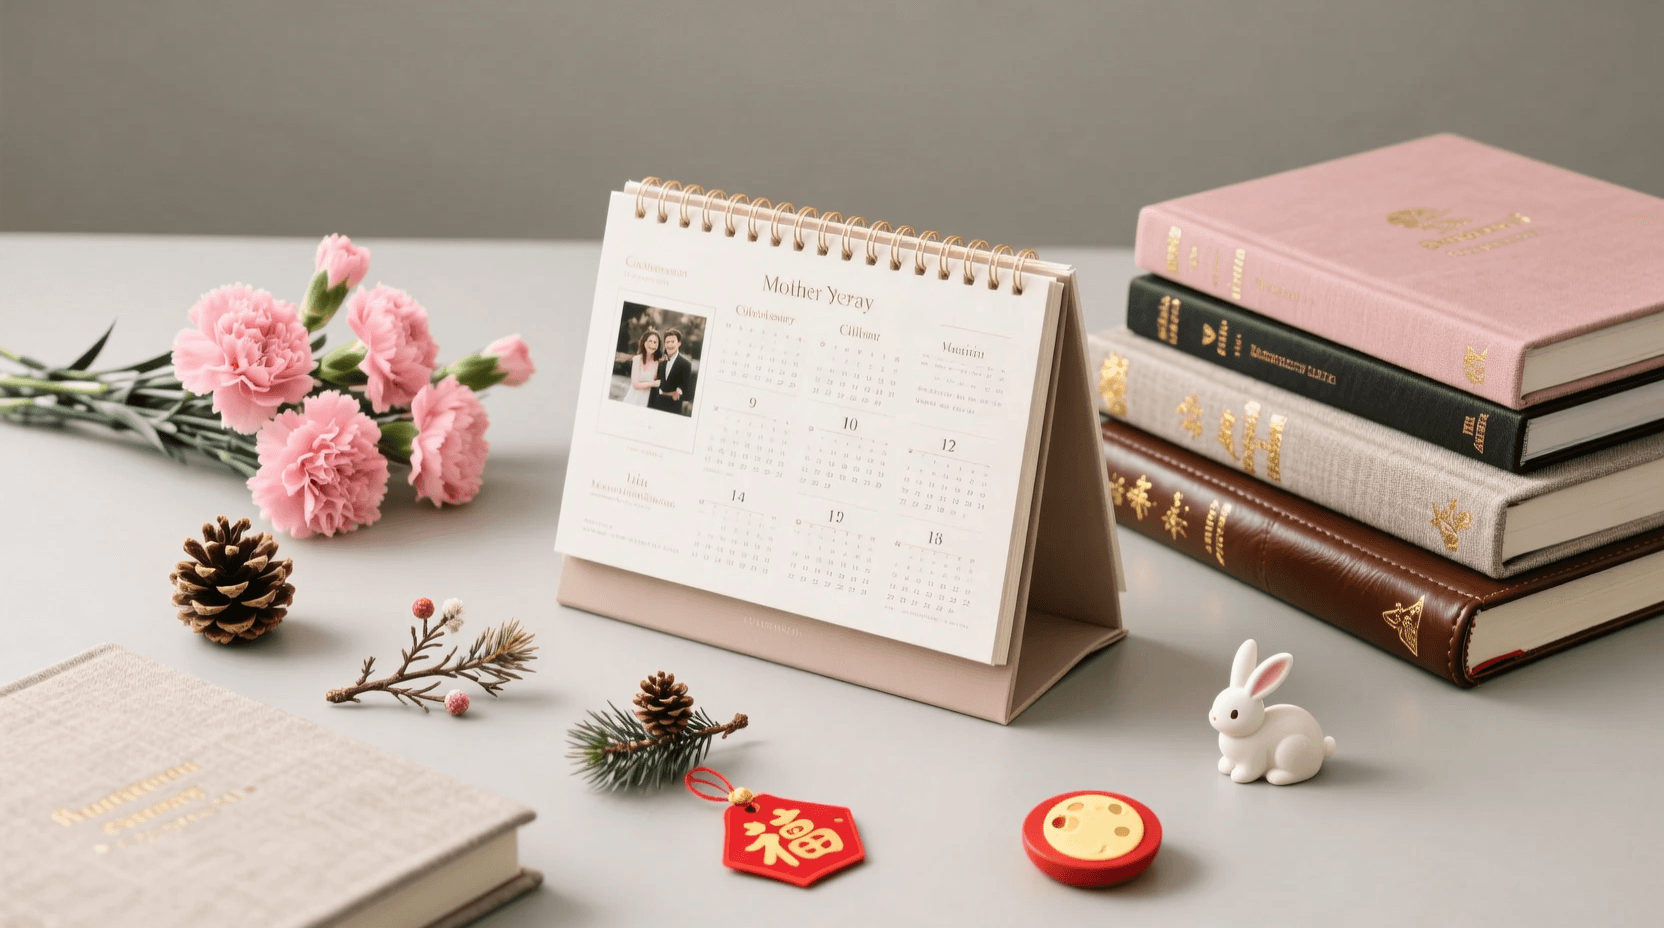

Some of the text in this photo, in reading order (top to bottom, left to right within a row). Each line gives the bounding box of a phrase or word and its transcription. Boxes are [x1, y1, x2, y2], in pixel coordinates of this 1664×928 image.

[763, 274, 874, 314] Mother Yeray
[749, 397, 757, 409] 9
[843, 417, 858, 431] 10
[942, 438, 956, 452] 12
[731, 490, 746, 503] 14
[743, 808, 844, 868] 福
